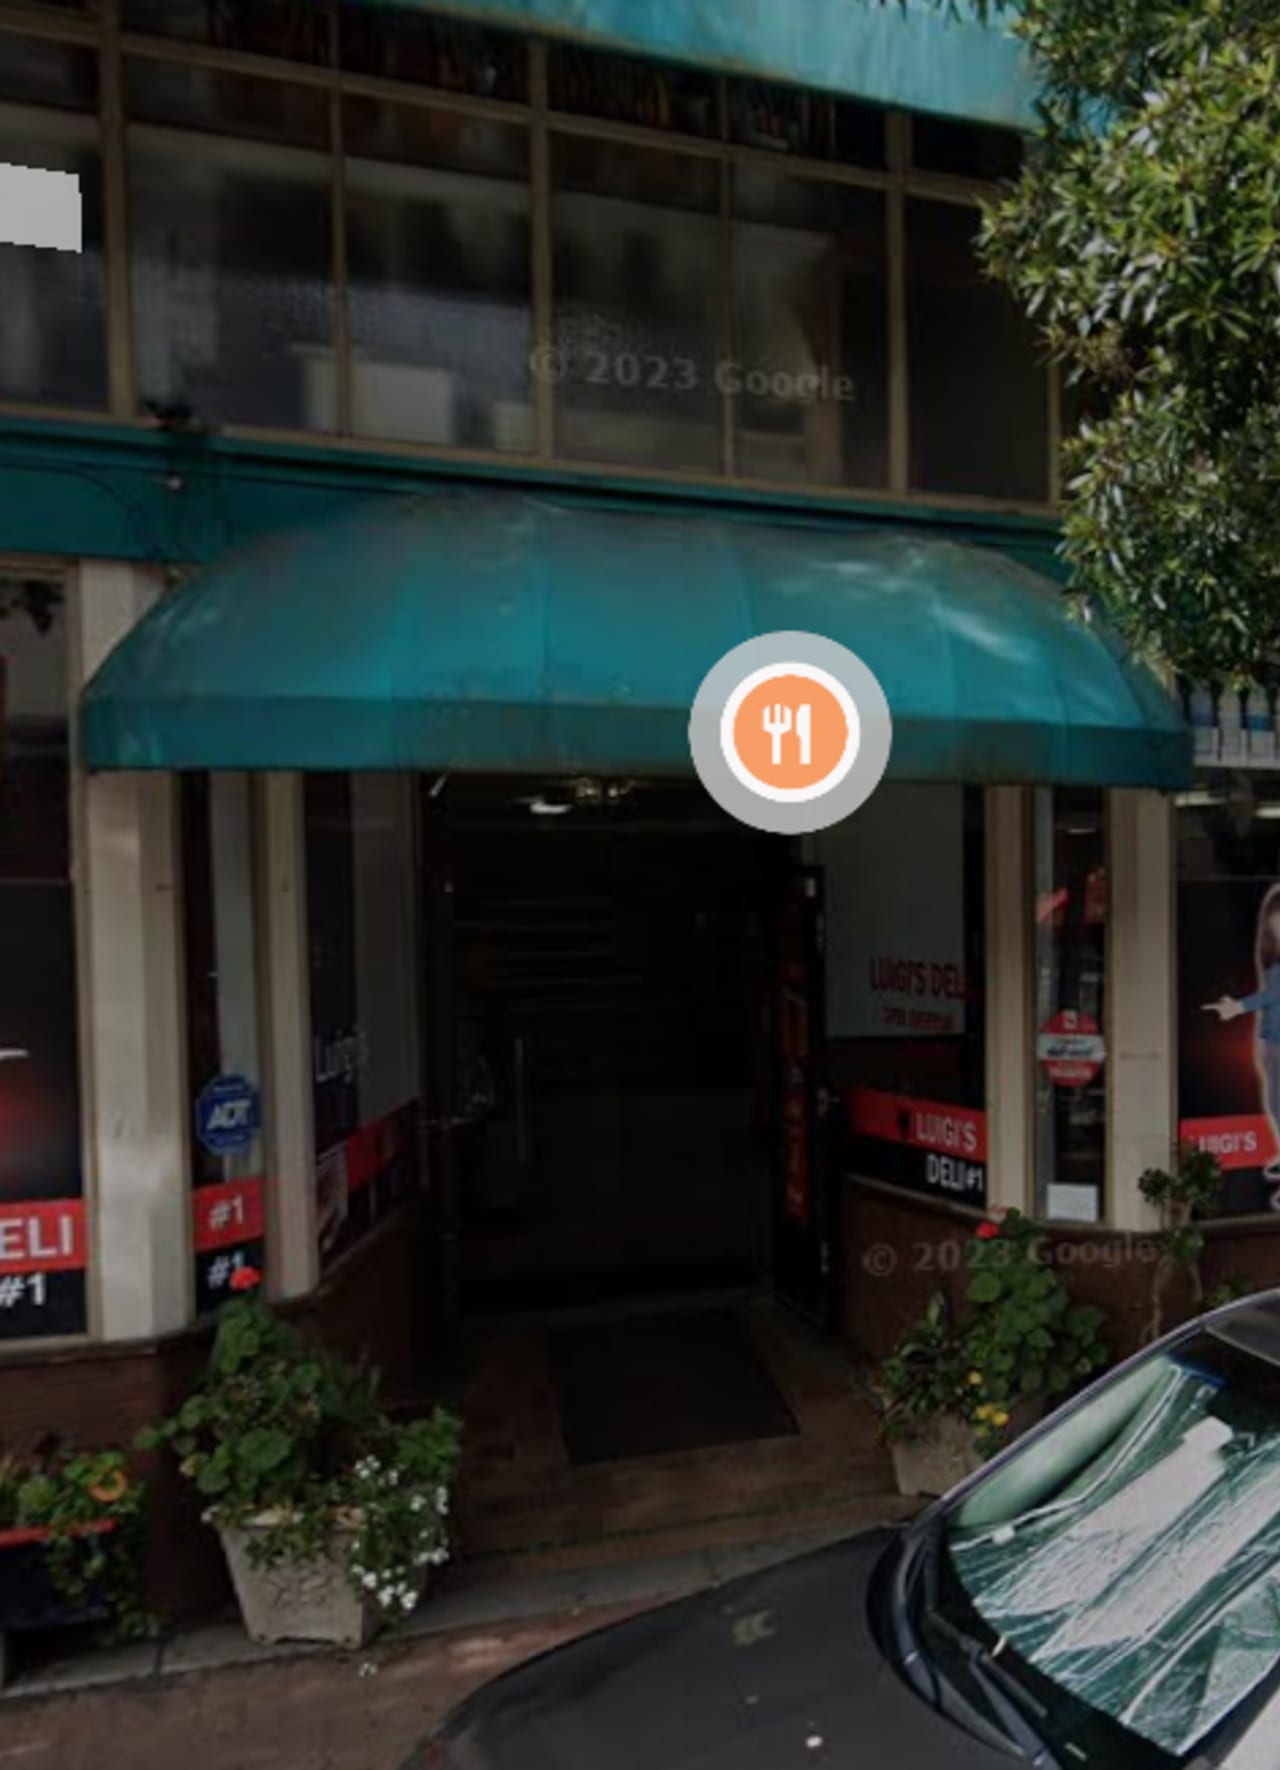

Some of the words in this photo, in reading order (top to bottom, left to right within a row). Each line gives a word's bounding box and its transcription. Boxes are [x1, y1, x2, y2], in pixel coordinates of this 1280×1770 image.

[206, 1099, 251, 1129] ADT
[916, 1112, 977, 1153] LUIGI'S
[208, 1196, 245, 1231] #1
[0, 1272, 46, 1307] #1
